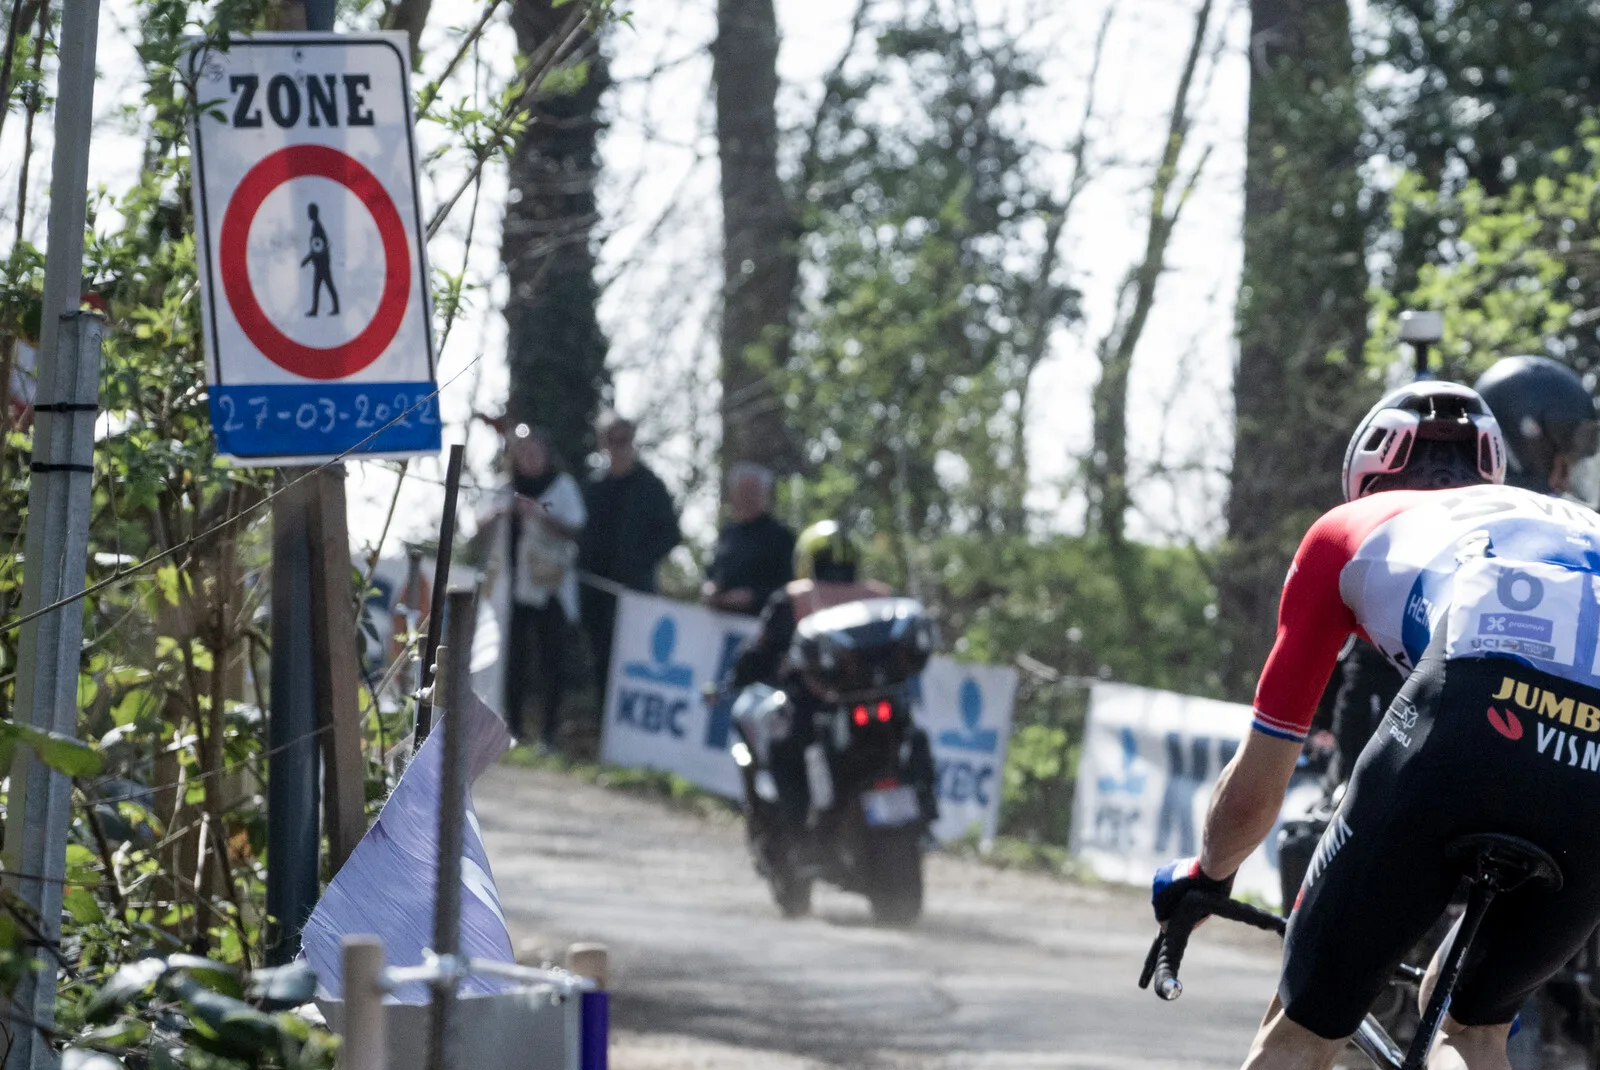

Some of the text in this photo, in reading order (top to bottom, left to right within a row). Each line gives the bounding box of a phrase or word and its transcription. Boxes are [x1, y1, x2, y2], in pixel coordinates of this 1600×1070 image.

[228, 73, 375, 129] ZONE
[218, 392, 438, 434] 27-03-2022
[1470, 637, 1500, 649] UCI
[616, 690, 688, 738] KBC
[1389, 727, 1412, 748] AGU
